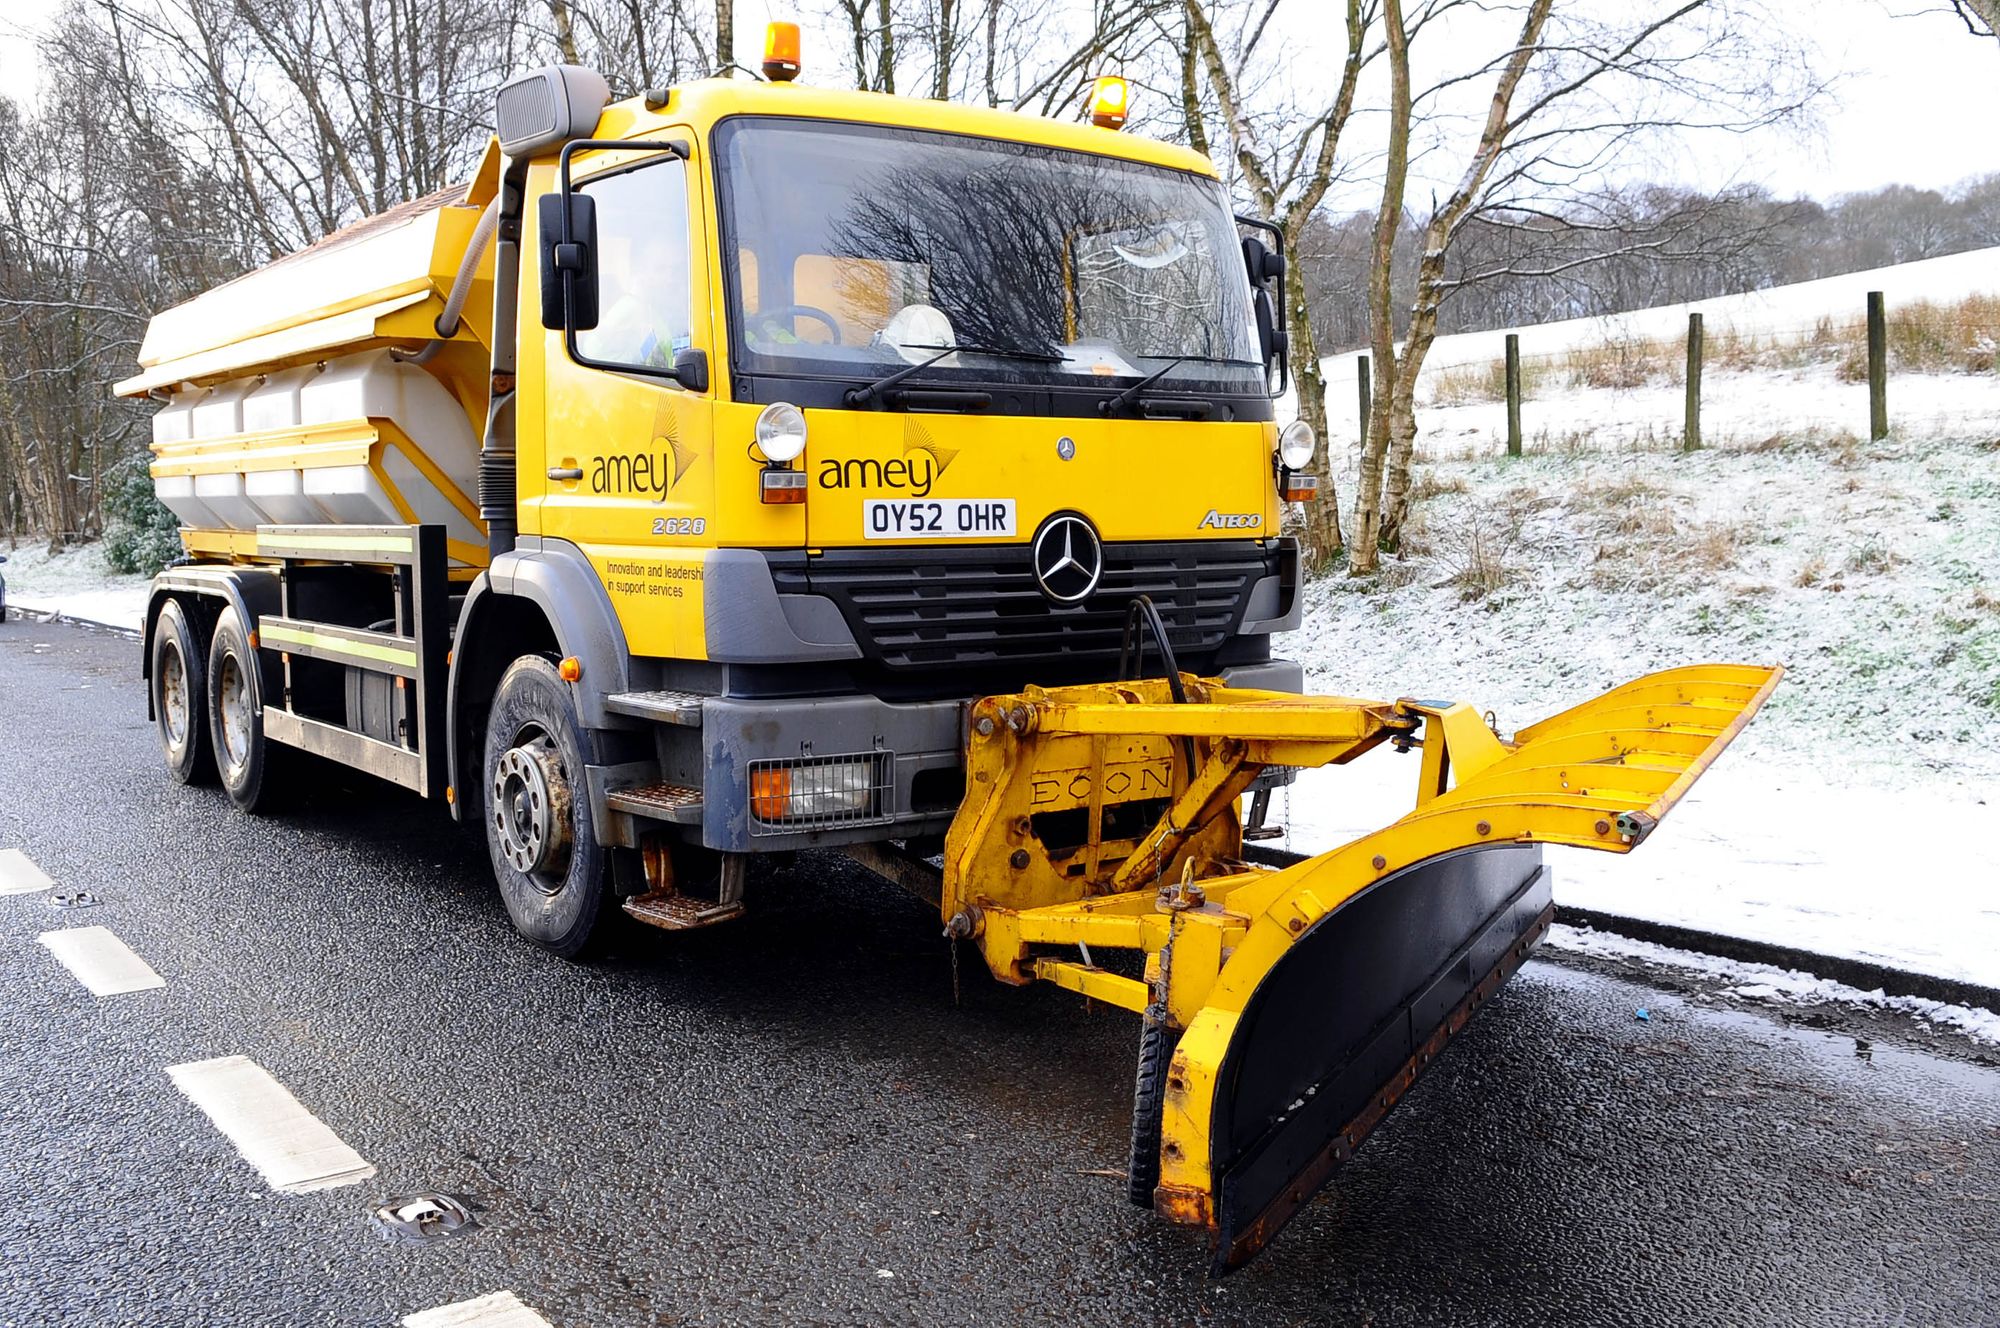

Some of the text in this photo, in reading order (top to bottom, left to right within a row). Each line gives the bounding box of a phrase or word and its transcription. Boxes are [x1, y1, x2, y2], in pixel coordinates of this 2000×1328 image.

[592, 453, 668, 504] amey
[818, 458, 931, 497] amey
[652, 518, 706, 535] 2628
[872, 503, 1006, 532] OY52 OHR
[606, 560, 704, 581] Innovation and leadershi
[607, 578, 683, 598] in support services
[1031, 761, 1172, 804] ECON
